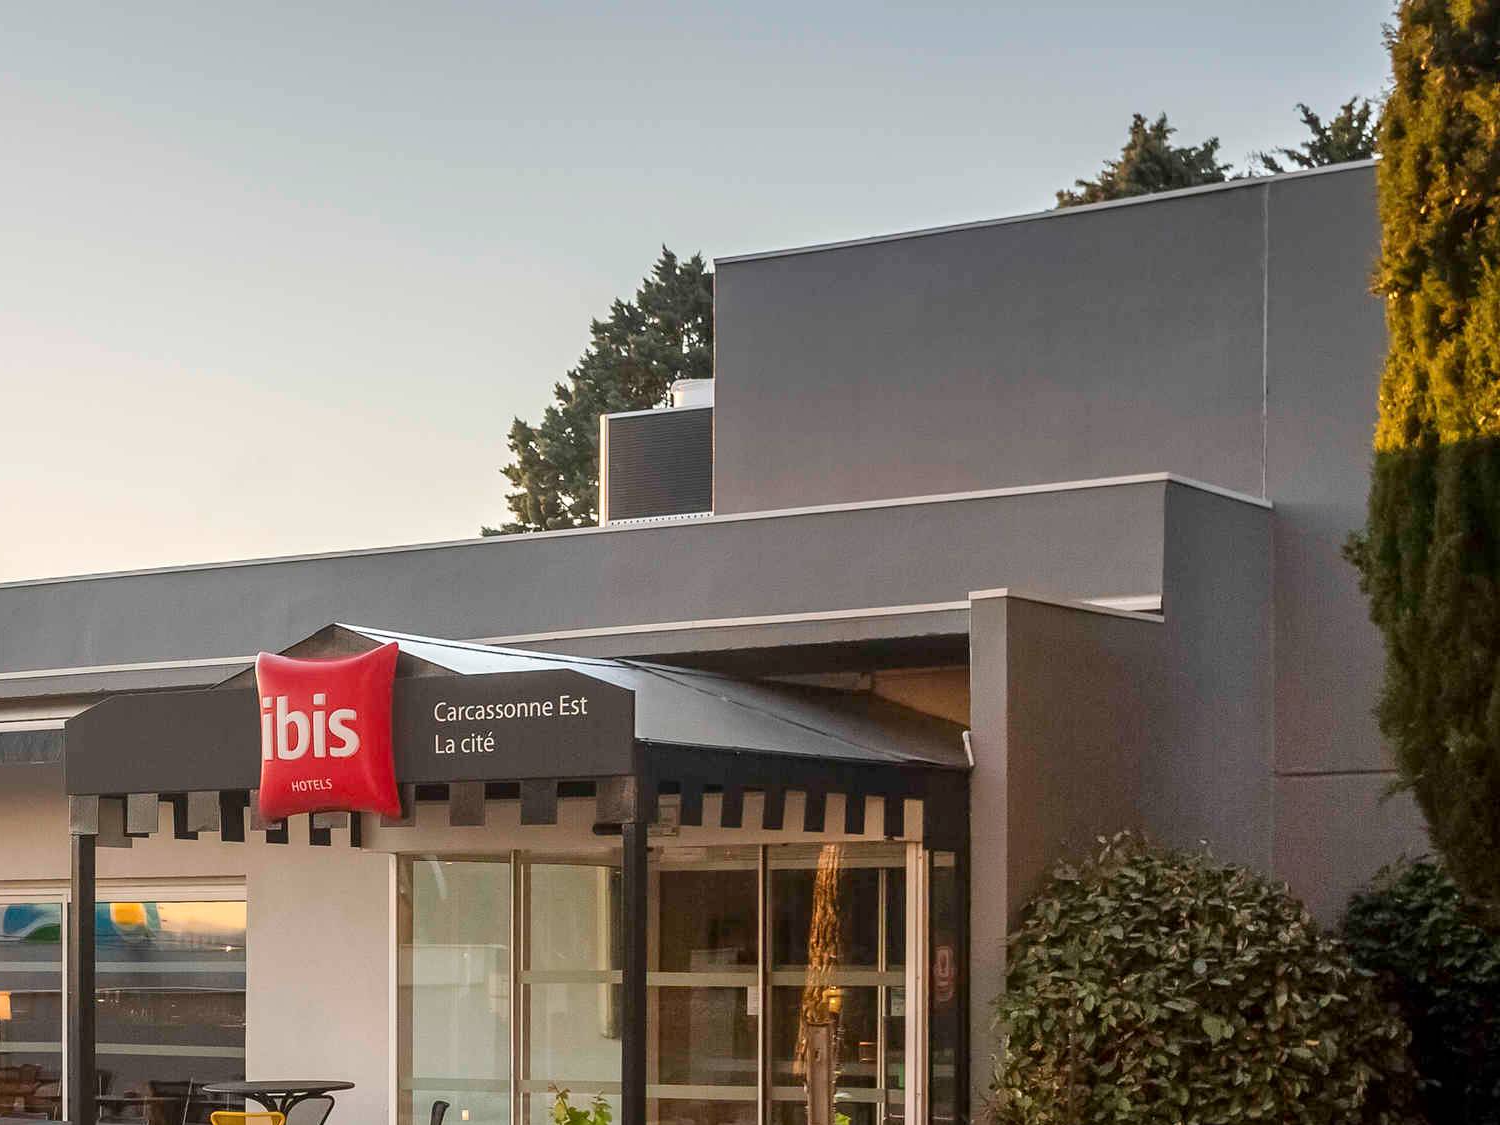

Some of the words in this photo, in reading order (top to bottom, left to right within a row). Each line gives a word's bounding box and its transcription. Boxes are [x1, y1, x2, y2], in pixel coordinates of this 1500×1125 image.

[433, 699, 554, 723] Carcassonne
[559, 696, 588, 716] Est
[262, 693, 361, 761] ibis
[434, 734, 456, 754] La
[460, 731, 495, 753] cité
[291, 778, 333, 792] HOTELS
